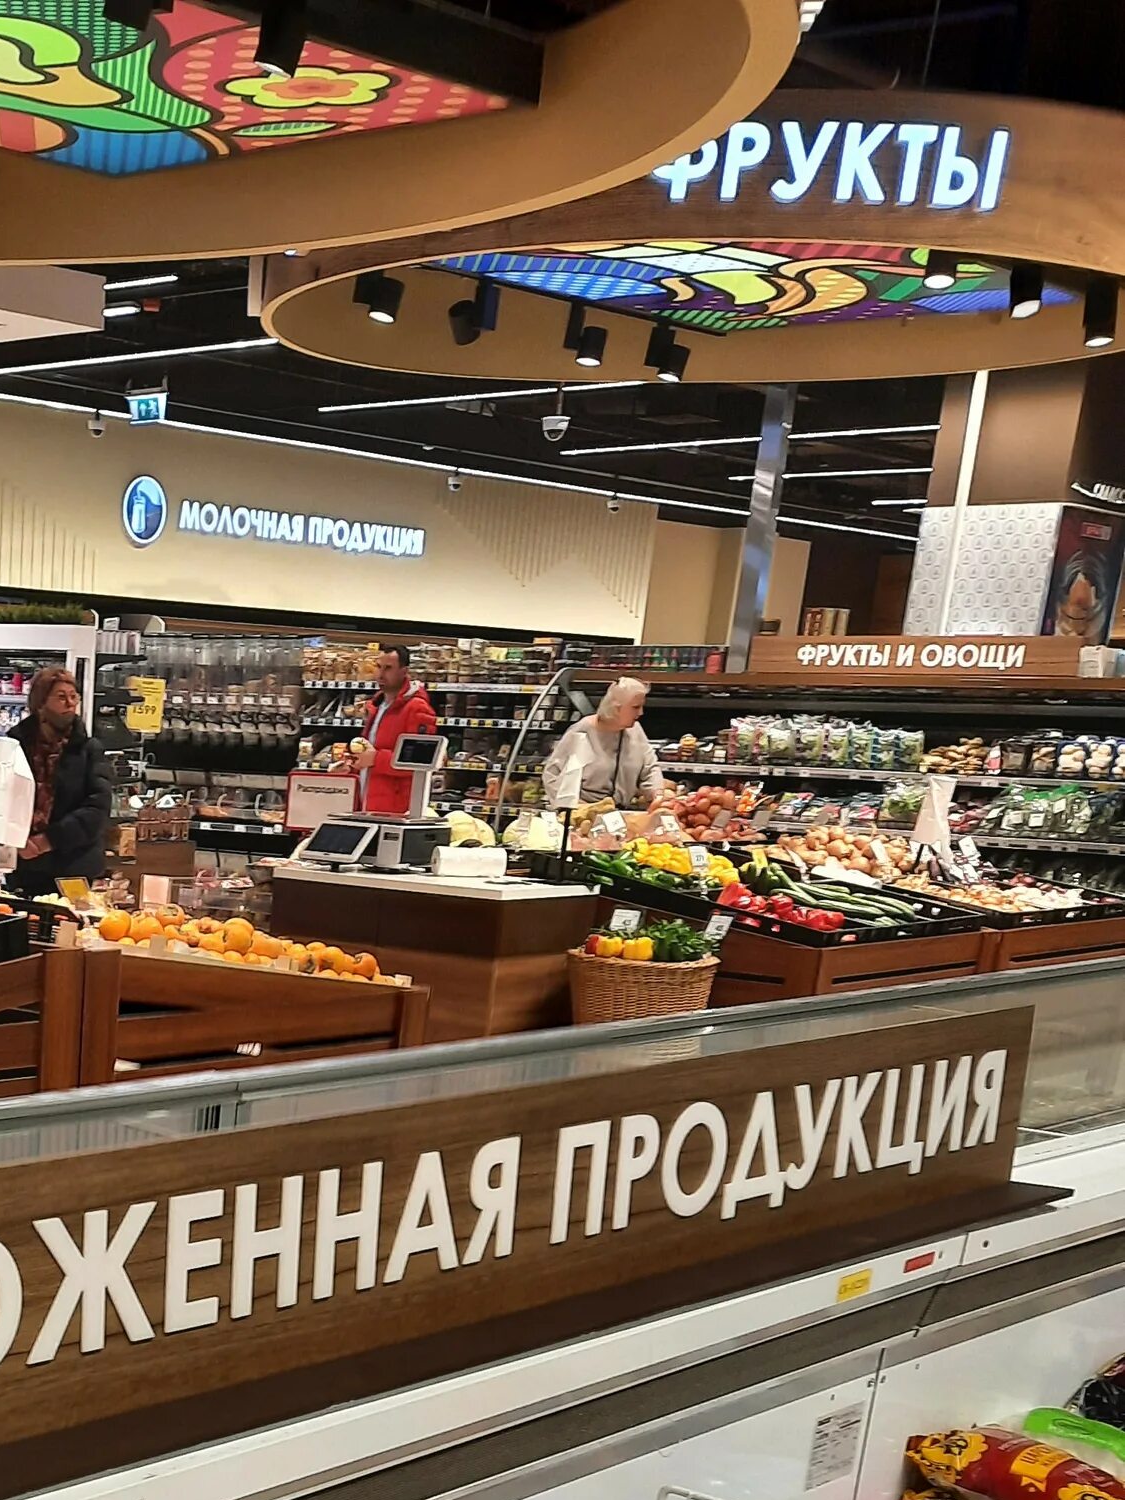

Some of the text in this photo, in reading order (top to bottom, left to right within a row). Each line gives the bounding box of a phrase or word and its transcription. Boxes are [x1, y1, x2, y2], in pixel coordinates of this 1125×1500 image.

[178, 499, 426, 557] МОЛОЧНАЯ ПРОДУКЦИЯ
[797, 643, 1027, 671] ФРУКТЫ И ОВОЩИ
[549, 1048, 1010, 1244] ПРОДУКЦИЯ
